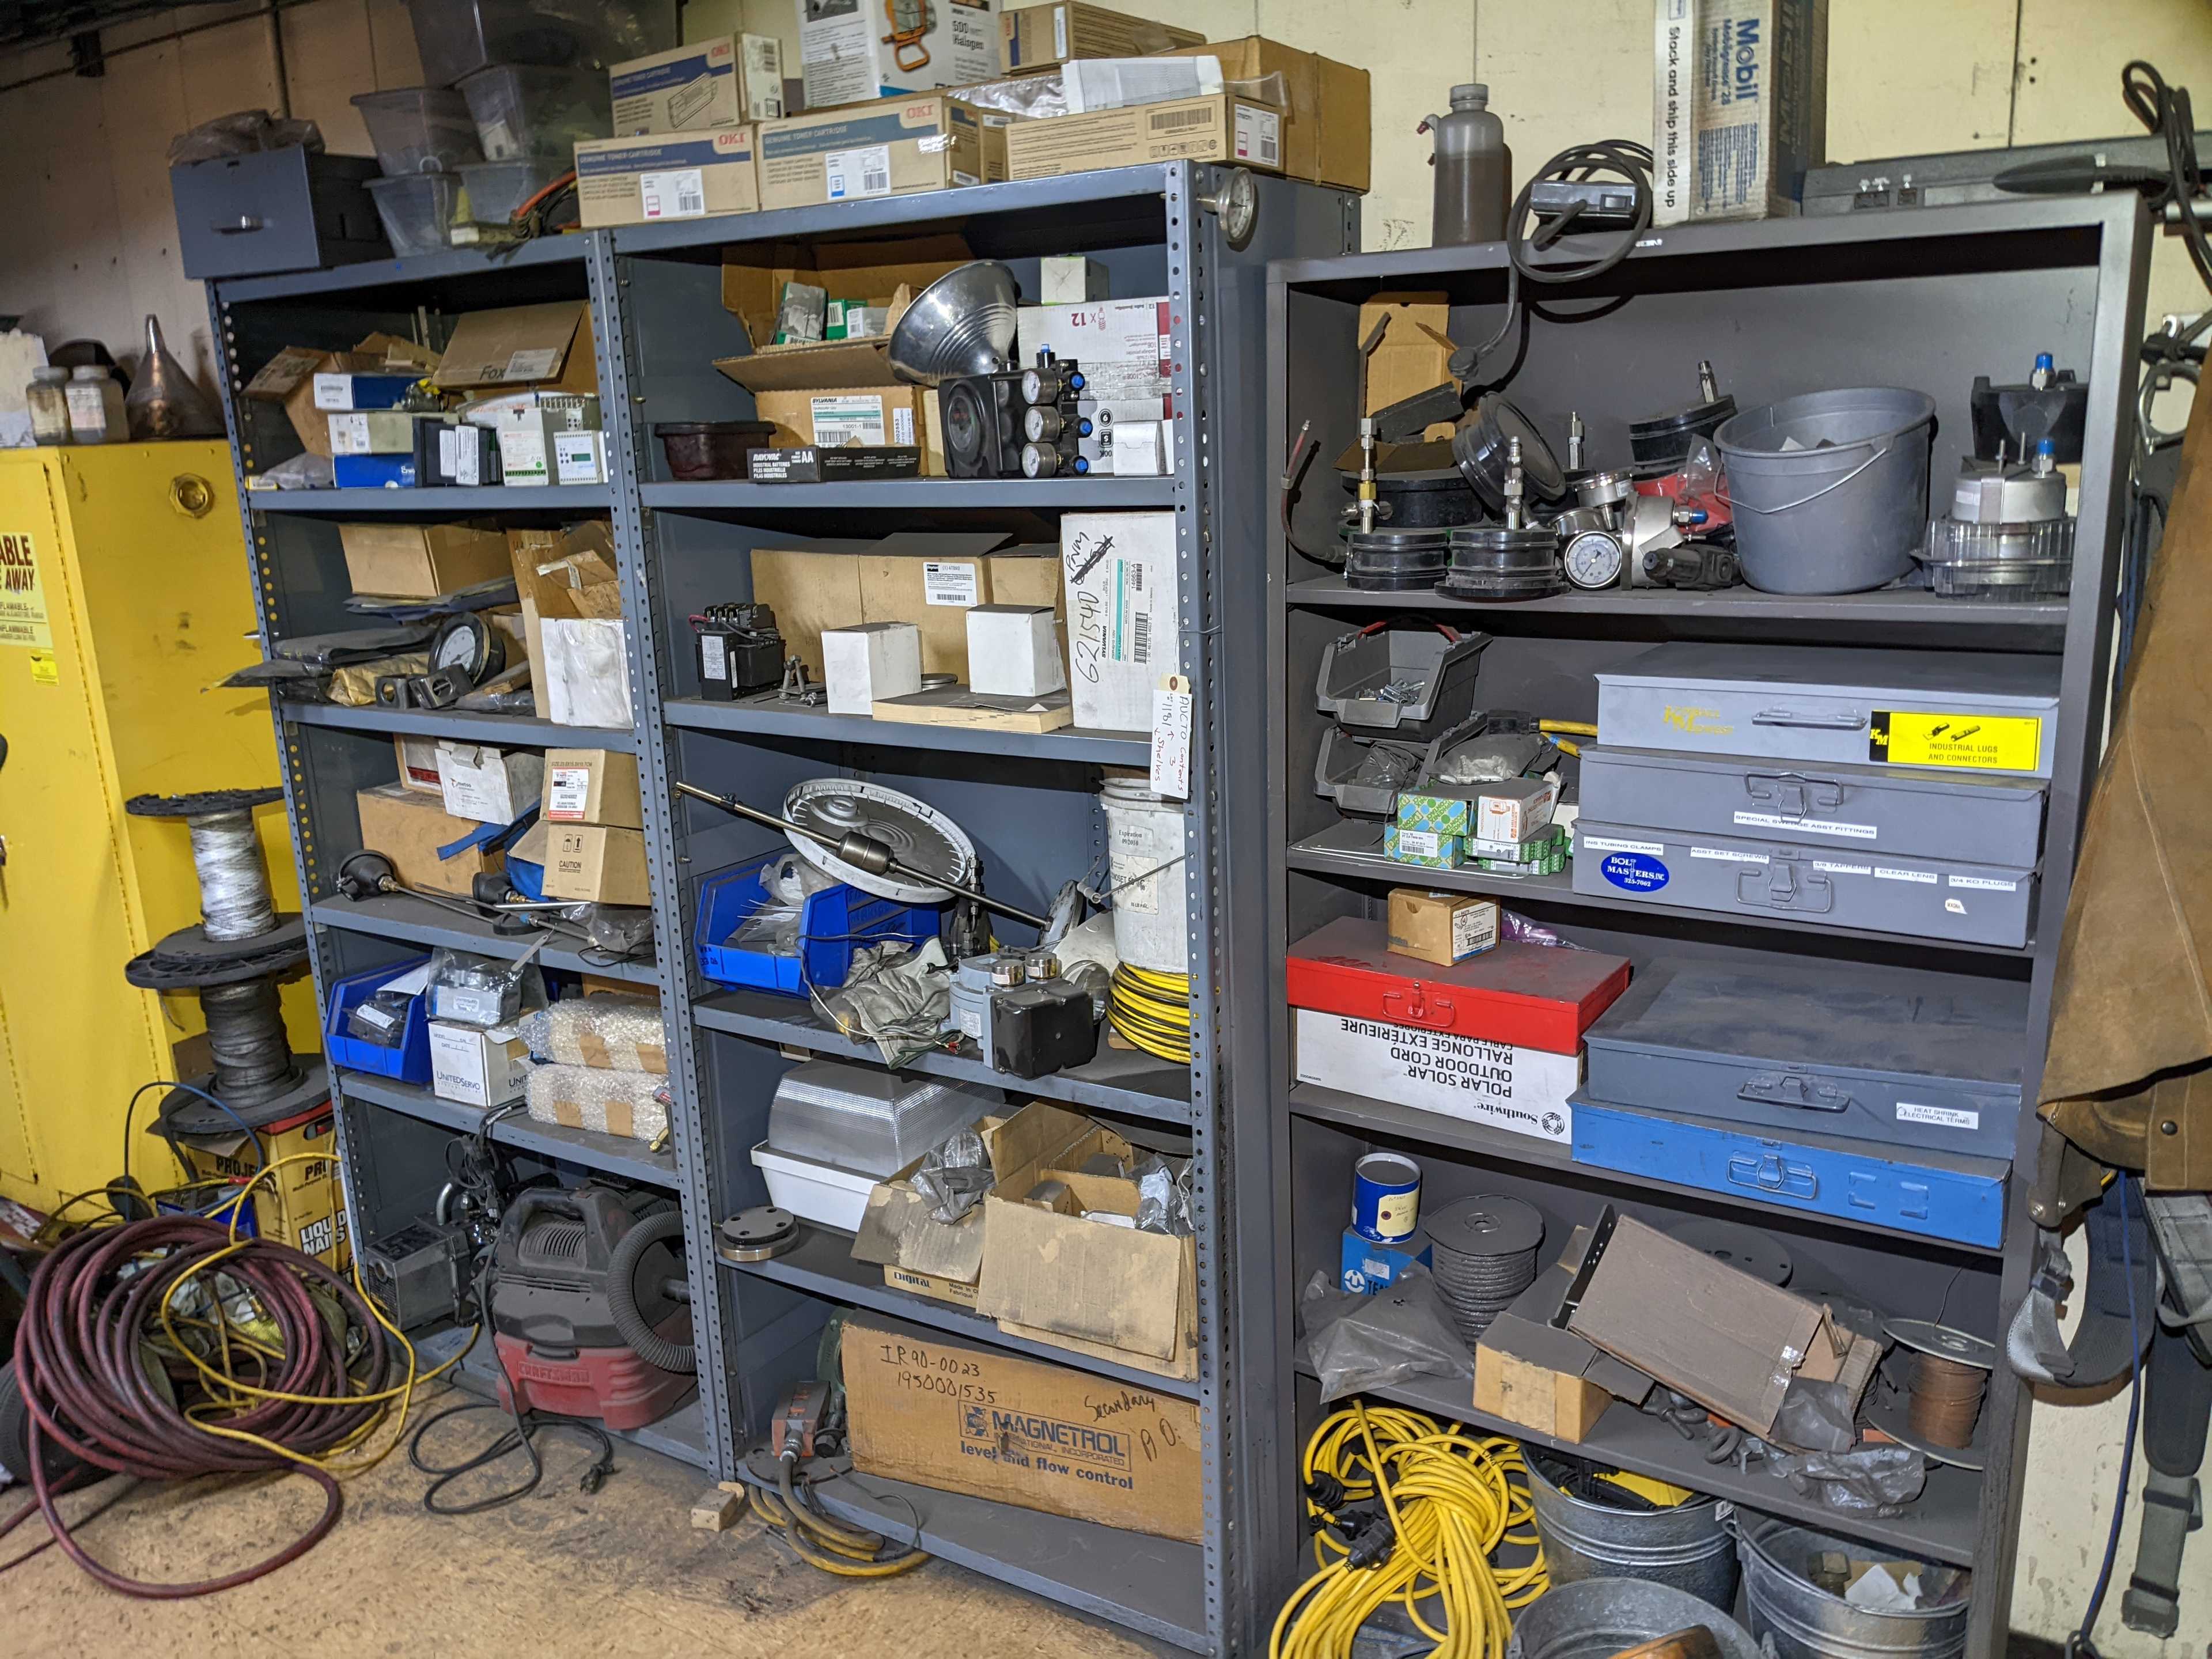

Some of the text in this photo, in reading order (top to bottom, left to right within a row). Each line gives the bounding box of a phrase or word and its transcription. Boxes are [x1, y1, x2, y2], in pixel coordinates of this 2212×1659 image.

[952, 34, 985, 51] Halogen
[1736, 18, 1760, 100] Mobil
[906, 104, 934, 119] OKI
[1665, 26, 1681, 209] Stack and ship this side up
[719, 132, 746, 145] OKI
[1071, 312, 1086, 327] 12
[480, 365, 506, 380] Fox
[752, 453, 780, 461] RAYOVAC
[801, 451, 814, 463] AA
[6, 568, 35, 592] AWAY
[1178, 695, 1190, 792] AUCTO Contents
[1929, 743, 1998, 753] INDUSTRIAL LUGS
[1154, 737, 1165, 781] Shelves
[1169, 756, 1176, 767] 3
[1946, 754, 1998, 764] CONNECTORS
[1736, 815, 1770, 824] SPECIAL
[1835, 826, 1875, 835] FITTINGS
[1119, 830, 1142, 838] Expiration
[1122, 838, 1139, 846] 09/2010
[1600, 841, 1628, 850] TUBING
[559, 860, 582, 869] CAUTION
[1611, 857, 1637, 867] BOLT
[1623, 877, 1652, 887] 325-7062
[1340, 1018, 1513, 1065] RALLONGE EXTÉRIEURE
[1390, 1046, 1513, 1082] OUTDOOR CORD
[1460, 1075, 1512, 1098] POLAR
[1904, 1111, 1970, 1125] ELECTRICAL TERMS
[1934, 1109, 1959, 1118] SHRINK
[300, 1209, 347, 1243] LIQUD
[303, 1228, 346, 1256] NAIS
[949, 1282, 964, 1290] Made
[520, 1363, 589, 1382] CRAFTSMAN
[897, 1371, 997, 1403] 1950001535
[1085, 1390, 1156, 1423] Secondary
[991, 1411, 1126, 1457] MAGNETROL
[1061, 1446, 1125, 1467] INCORPORATED
[960, 1440, 997, 1459] level
[1036, 1457, 1069, 1475] flow
[1075, 1467, 1134, 1490] control
